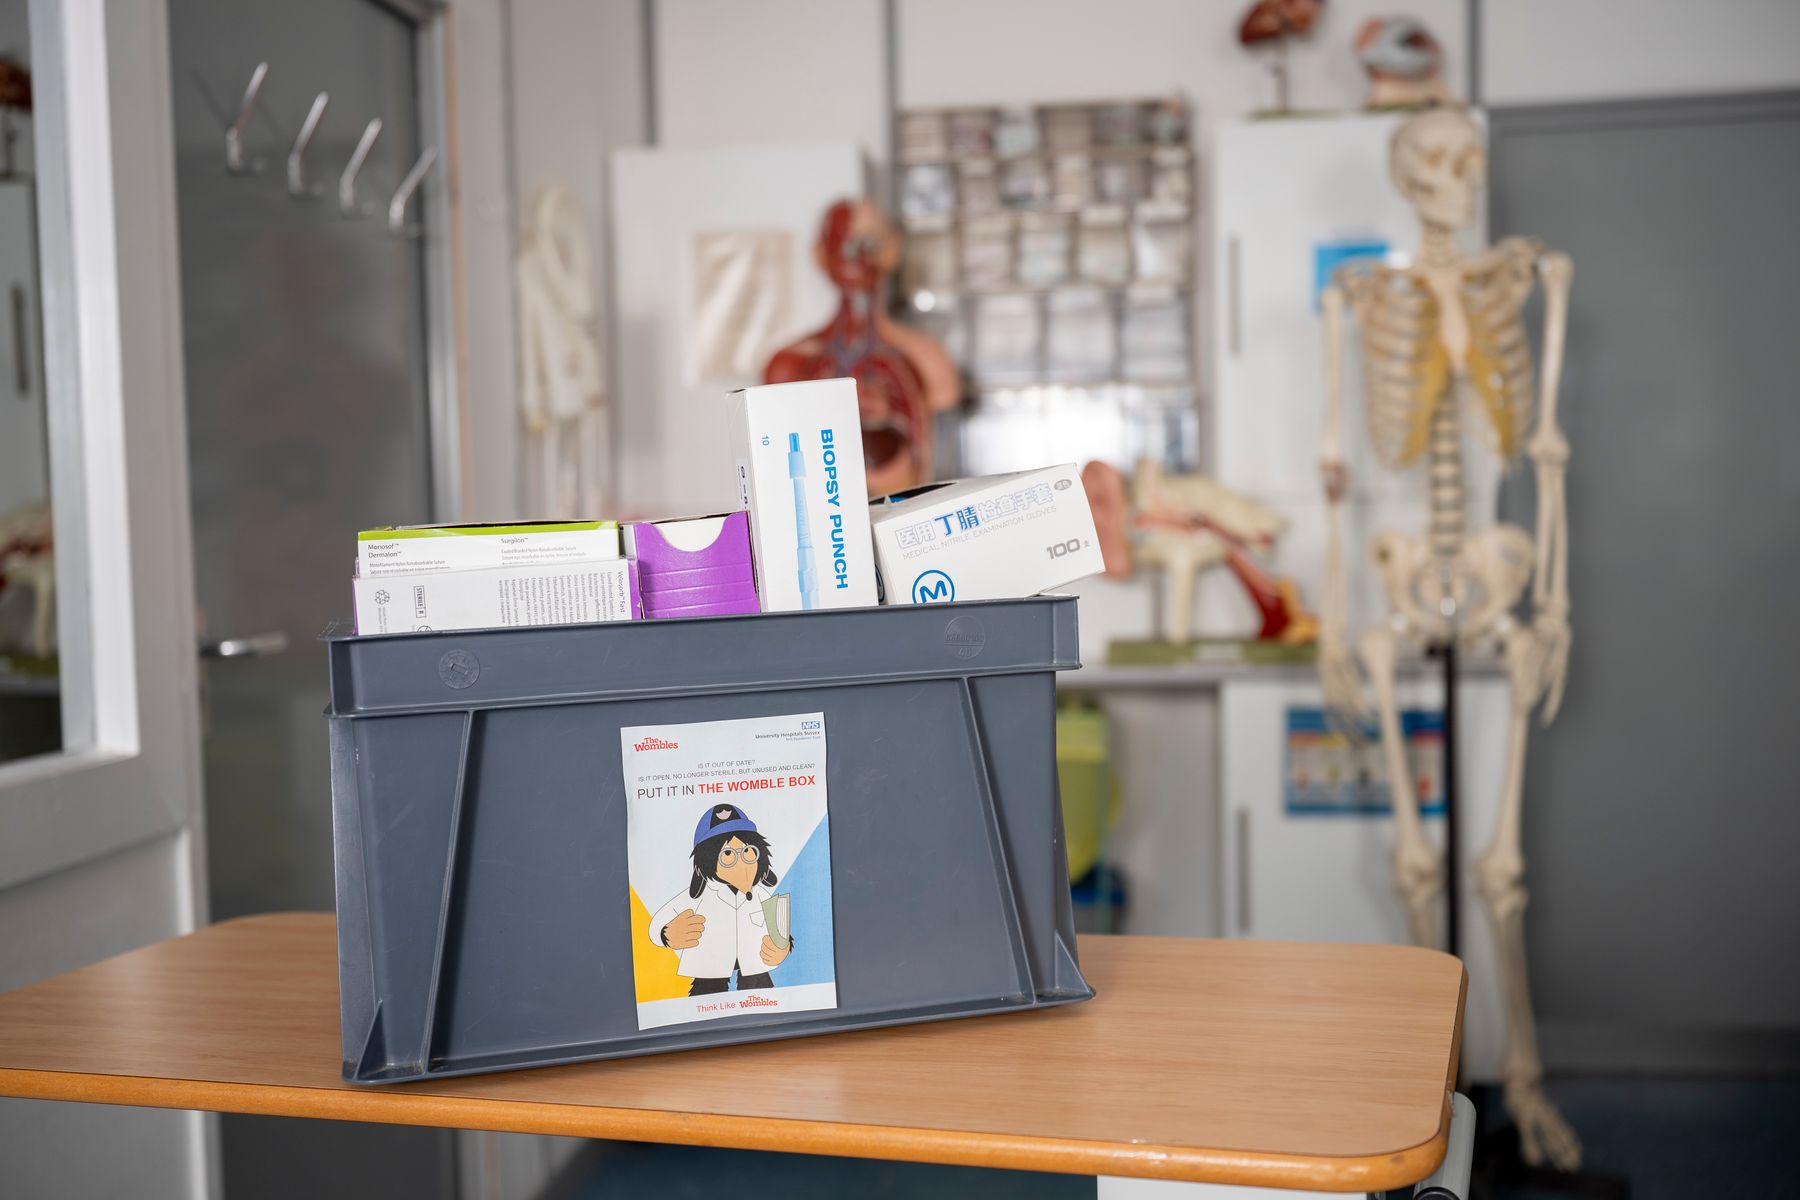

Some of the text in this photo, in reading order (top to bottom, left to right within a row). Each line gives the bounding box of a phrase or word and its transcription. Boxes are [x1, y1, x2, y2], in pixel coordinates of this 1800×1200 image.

[762, 436, 770, 446] 10
[820, 428, 848, 590] BIOPSY PUNCH
[902, 506, 1057, 560] MEDICAL NITRILE EXAMINATION GLOVES
[1046, 538, 1081, 560] 100
[802, 721, 820, 729] NHS
[634, 740, 679, 752] Wombles
[637, 775, 816, 800] PUT IT IN THE WOMBLE BOX
[696, 999, 778, 1013] Think Like Wombles
